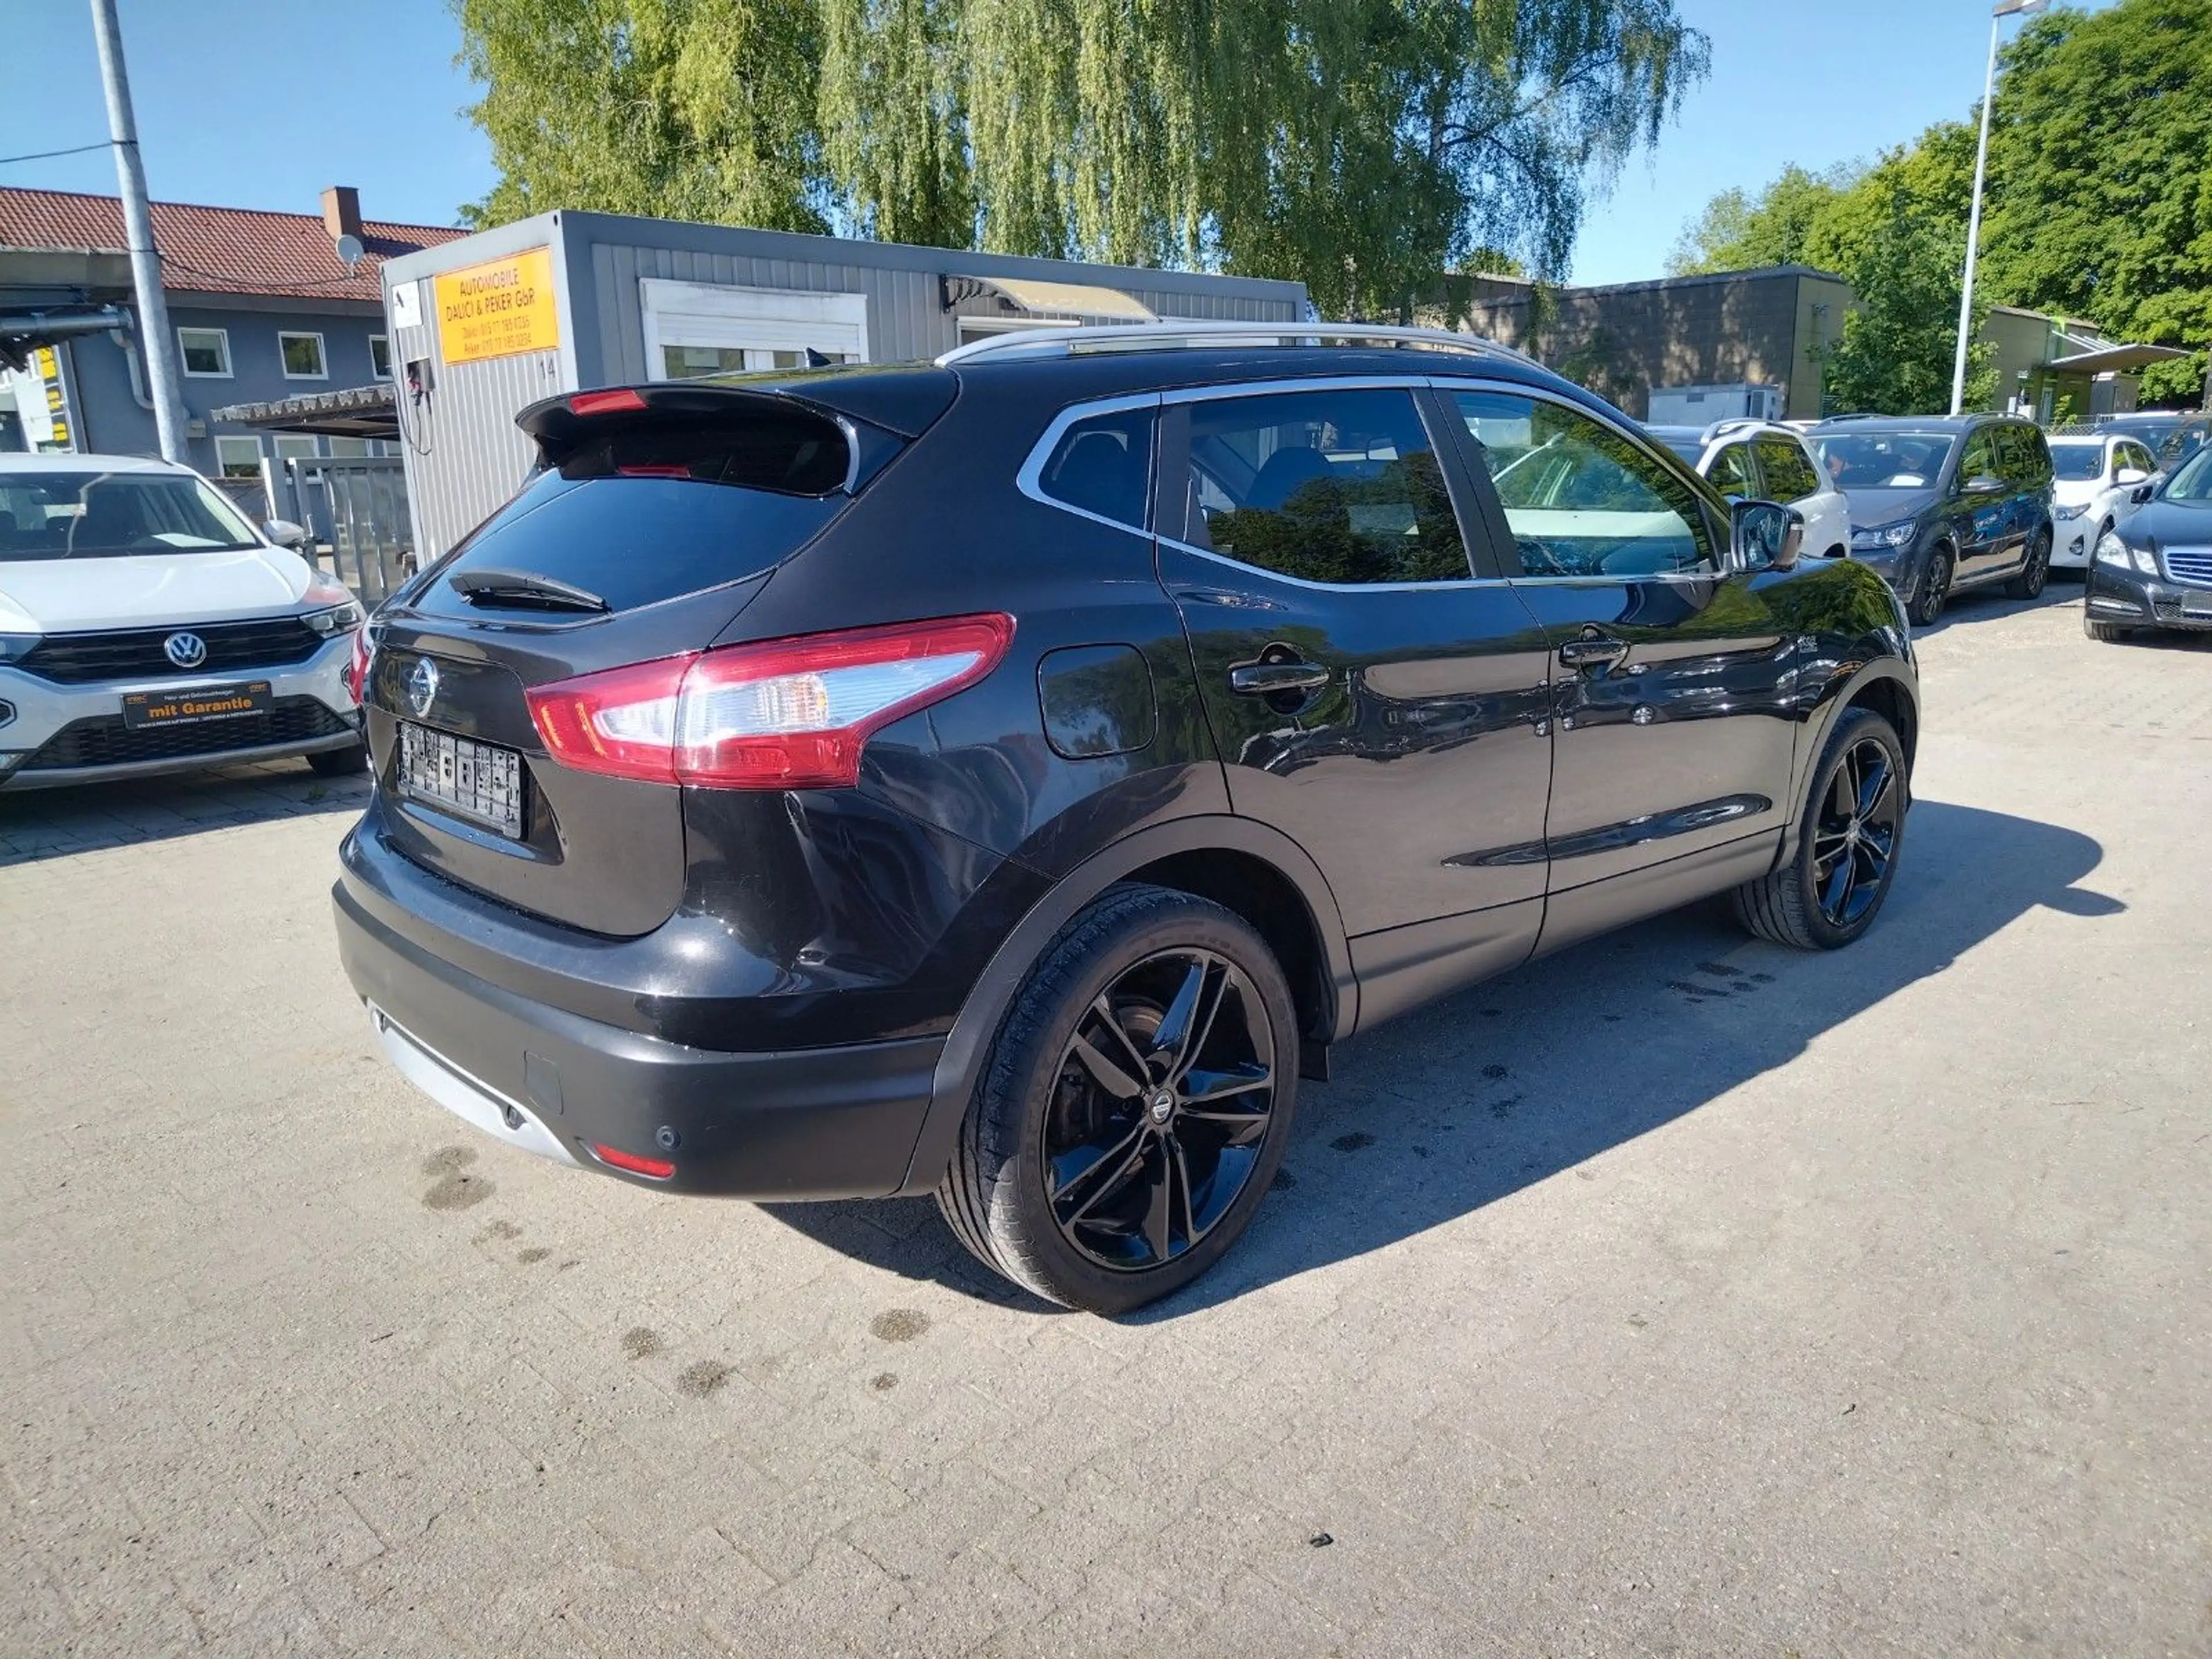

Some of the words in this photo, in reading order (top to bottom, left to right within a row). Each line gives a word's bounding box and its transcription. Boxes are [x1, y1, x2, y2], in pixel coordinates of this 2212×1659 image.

[460, 268, 520, 297] AUTOMOBILE
[477, 300, 483, 316] &
[485, 293, 513, 313] PEKER
[516, 287, 536, 308] GbR
[540, 358, 556, 380] 14
[148, 704, 178, 718] mit
[182, 696, 253, 715] Garantie
